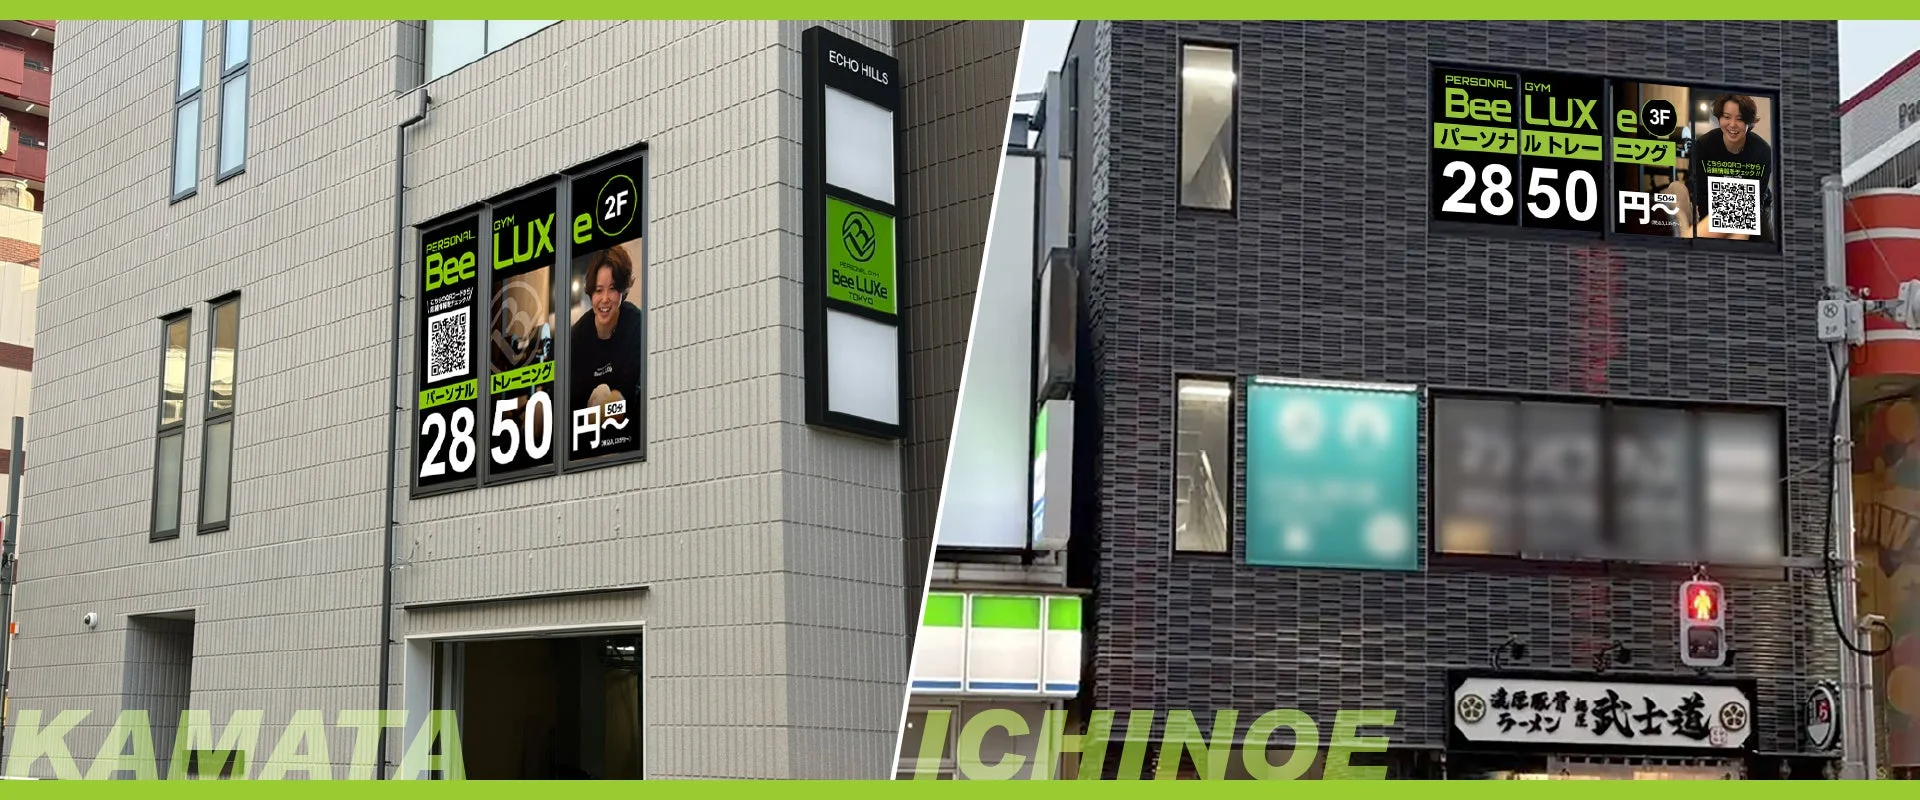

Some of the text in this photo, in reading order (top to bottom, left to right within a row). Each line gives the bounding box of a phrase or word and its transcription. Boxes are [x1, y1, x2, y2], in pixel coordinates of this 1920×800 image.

[829, 49, 890, 86] ECHO HILLS
[1445, 74, 1551, 93] PERSONAL GYM
[1445, 87, 1512, 123] Bee
[1649, 108, 1671, 126] 3F
[604, 189, 629, 220] 2F
[426, 214, 515, 253] PERSONAL GYM
[425, 249, 476, 292] Bee
[832, 268, 888, 300] Bee LUXe
[848, 290, 874, 305] TOKYO
[425, 363, 553, 406] パーソナル トレーニング
[1496, 712, 1562, 734] ラーメン
[1591, 688, 1711, 740] 武士道
